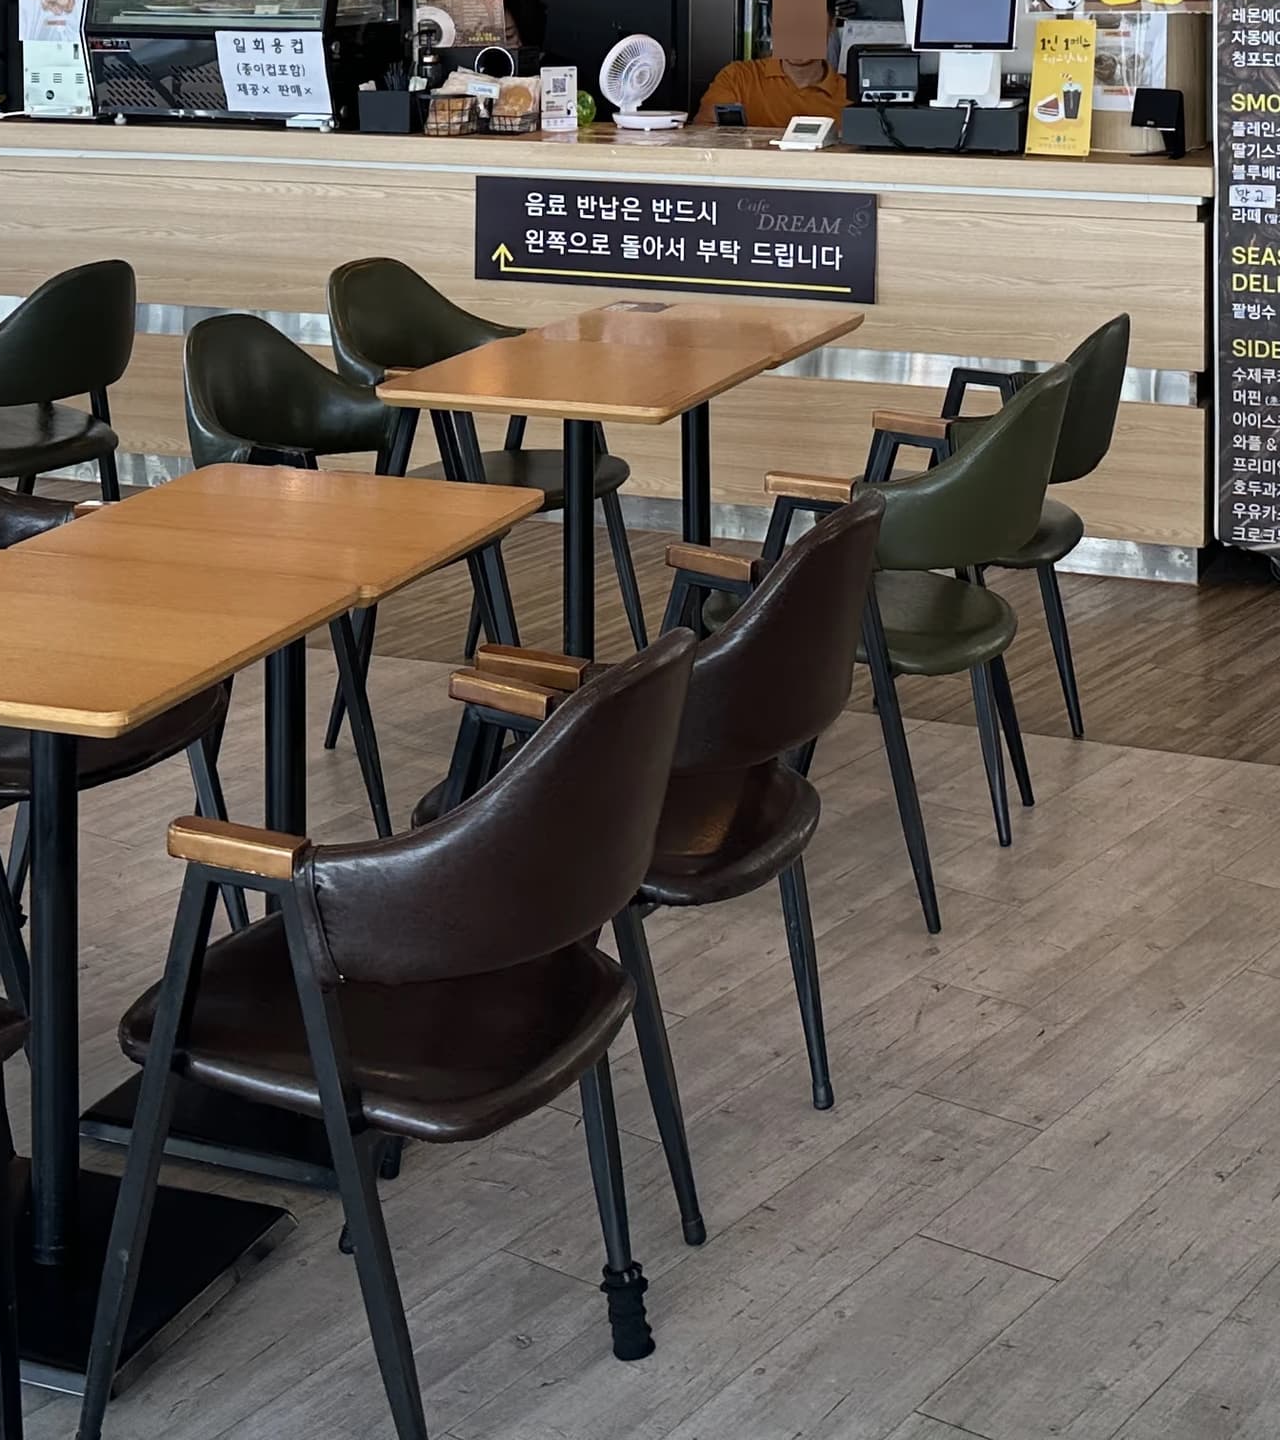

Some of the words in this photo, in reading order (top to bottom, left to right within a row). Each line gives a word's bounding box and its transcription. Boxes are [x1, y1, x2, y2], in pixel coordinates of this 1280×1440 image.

[525, 193, 567, 217] 음료
[577, 196, 642, 223] 반납은
[652, 198, 717, 226] 반드시
[1232, 208, 1261, 224] 라떼
[756, 213, 841, 235] DREAM
[525, 230, 610, 257] 왼쪽으로
[621, 234, 685, 261] 돌아서
[696, 238, 740, 265] 부탁
[751, 241, 842, 271] 드립니다
[1232, 389, 1261, 406] 머핀
[1232, 434, 1262, 452] 와플
[1267, 438, 1277, 452] &
